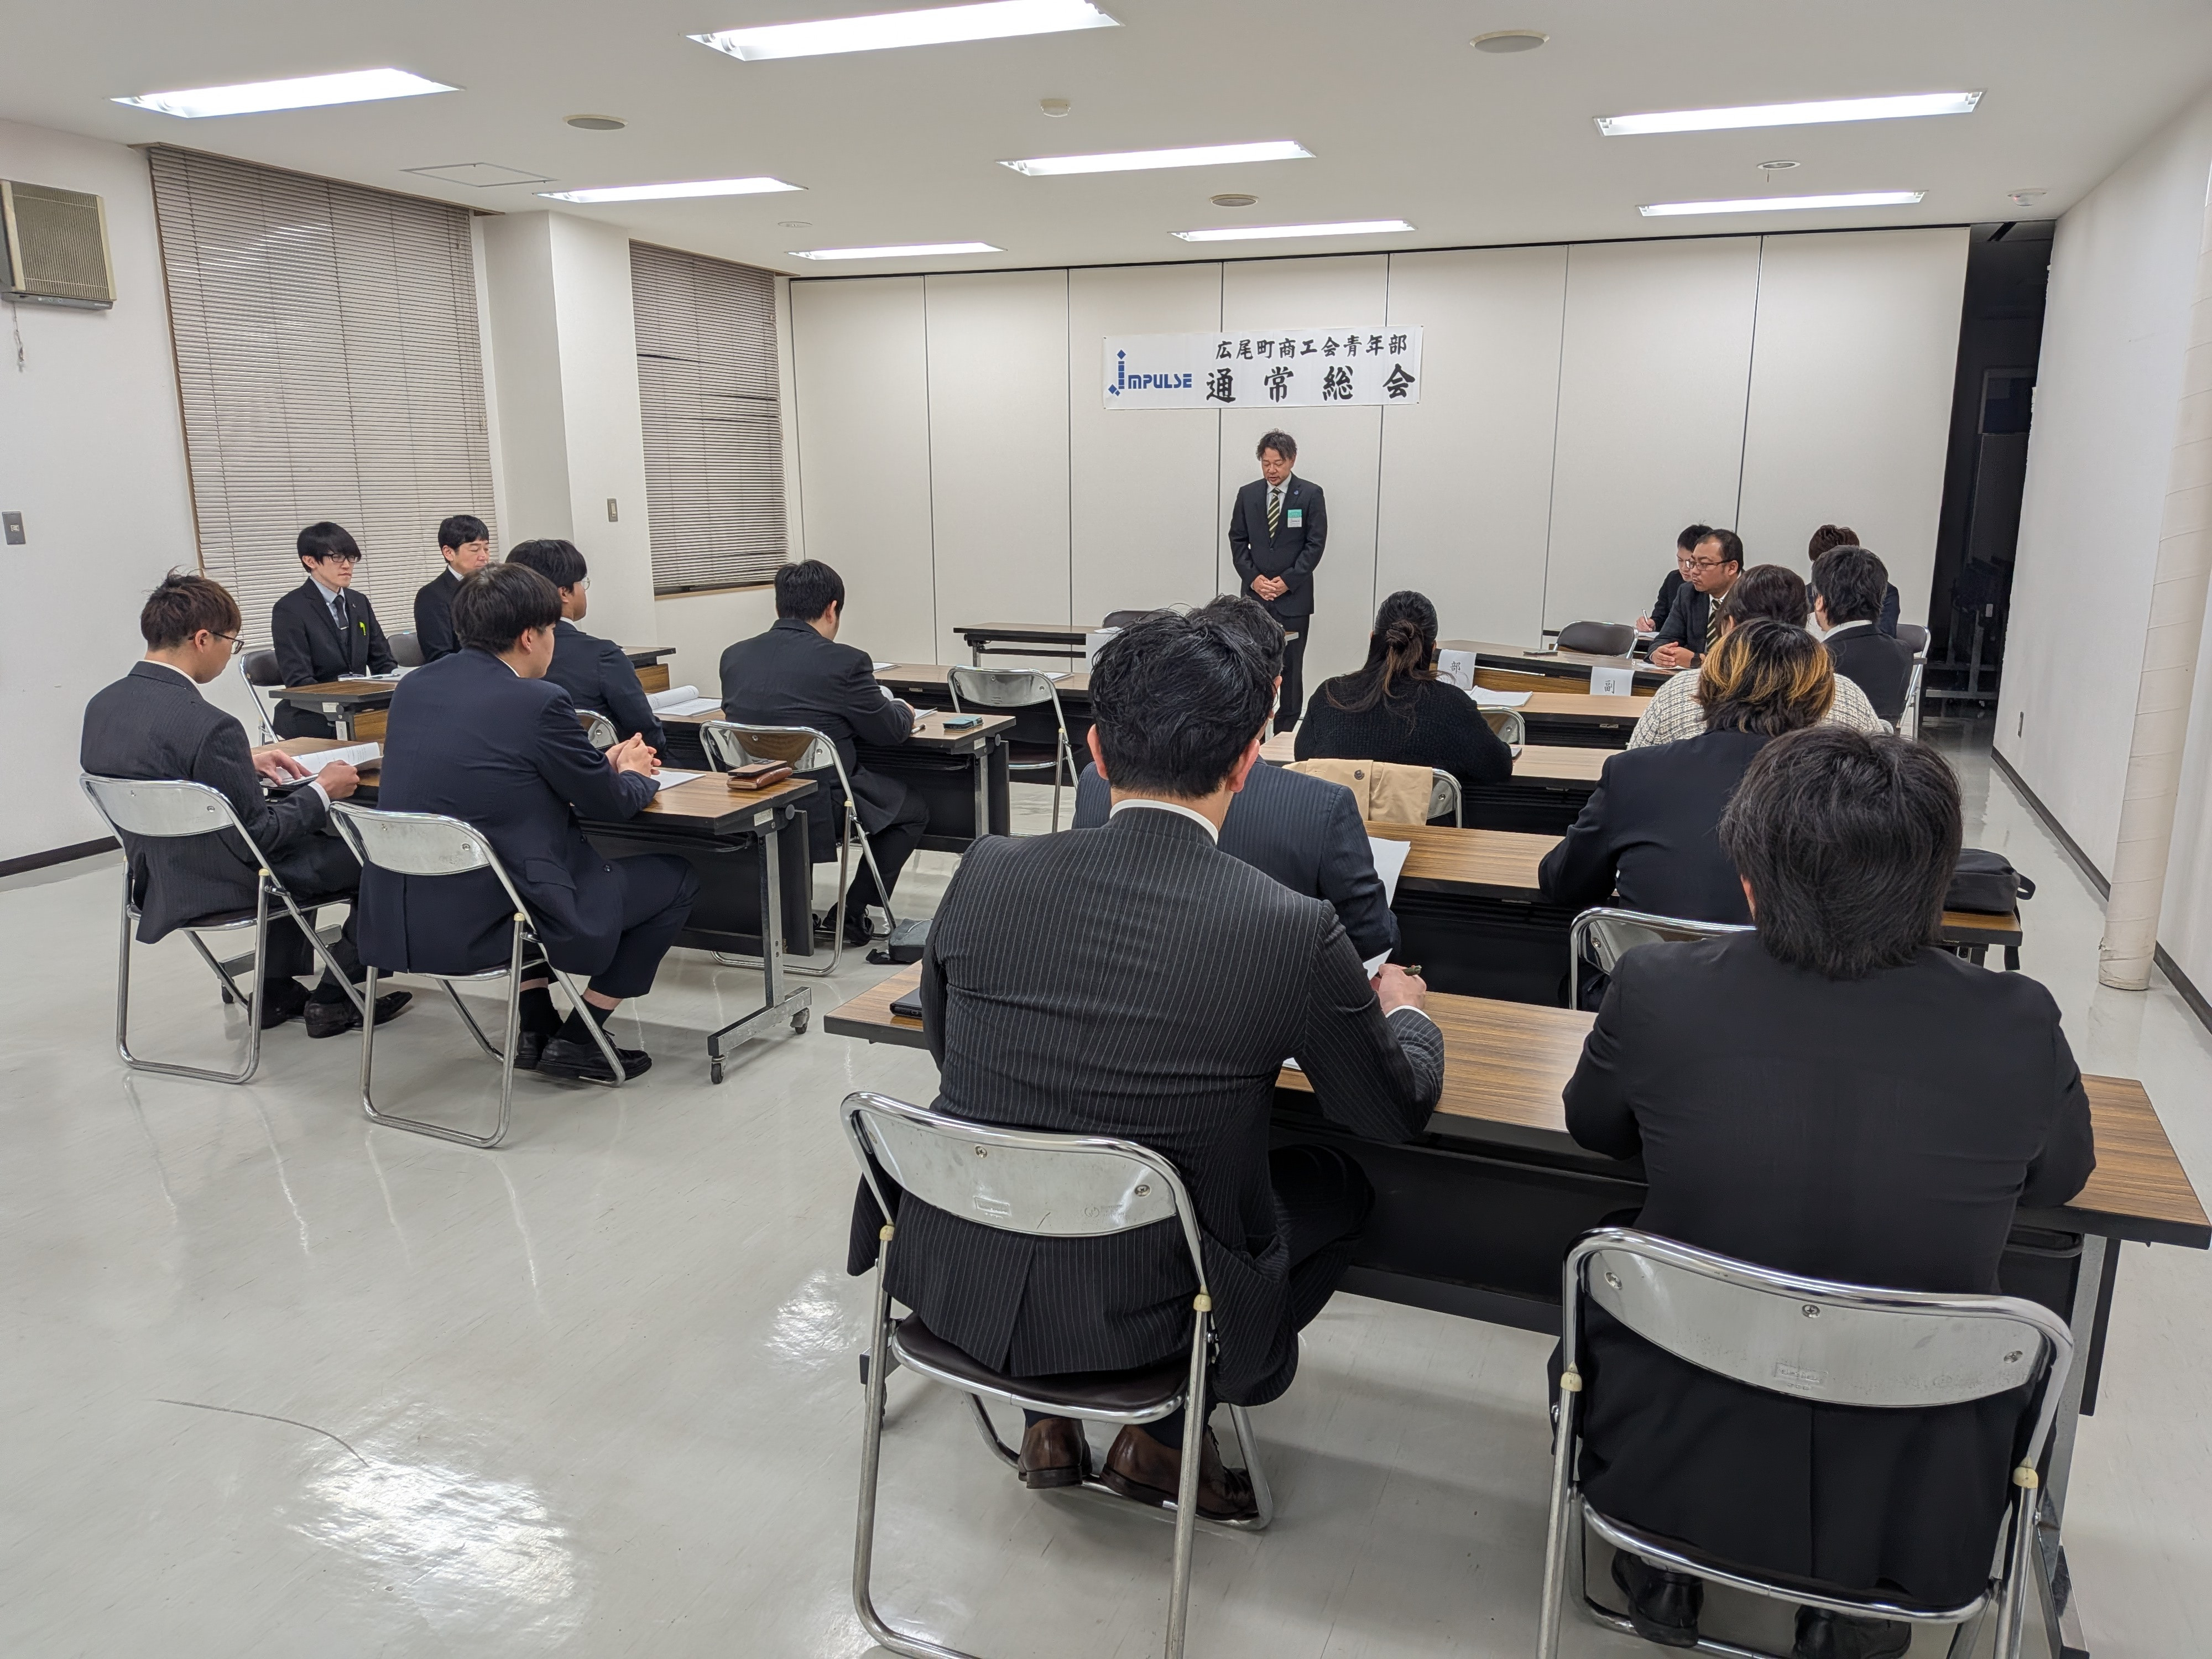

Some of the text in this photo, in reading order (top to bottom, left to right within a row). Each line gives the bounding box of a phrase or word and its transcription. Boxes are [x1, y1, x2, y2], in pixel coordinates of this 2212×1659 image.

[1215, 334, 1407, 360] 広尾町商工会青年部
[1206, 363, 1416, 404] 通常総会
[1450, 661, 1461, 675] 部
[1604, 680, 1615, 694] 副
